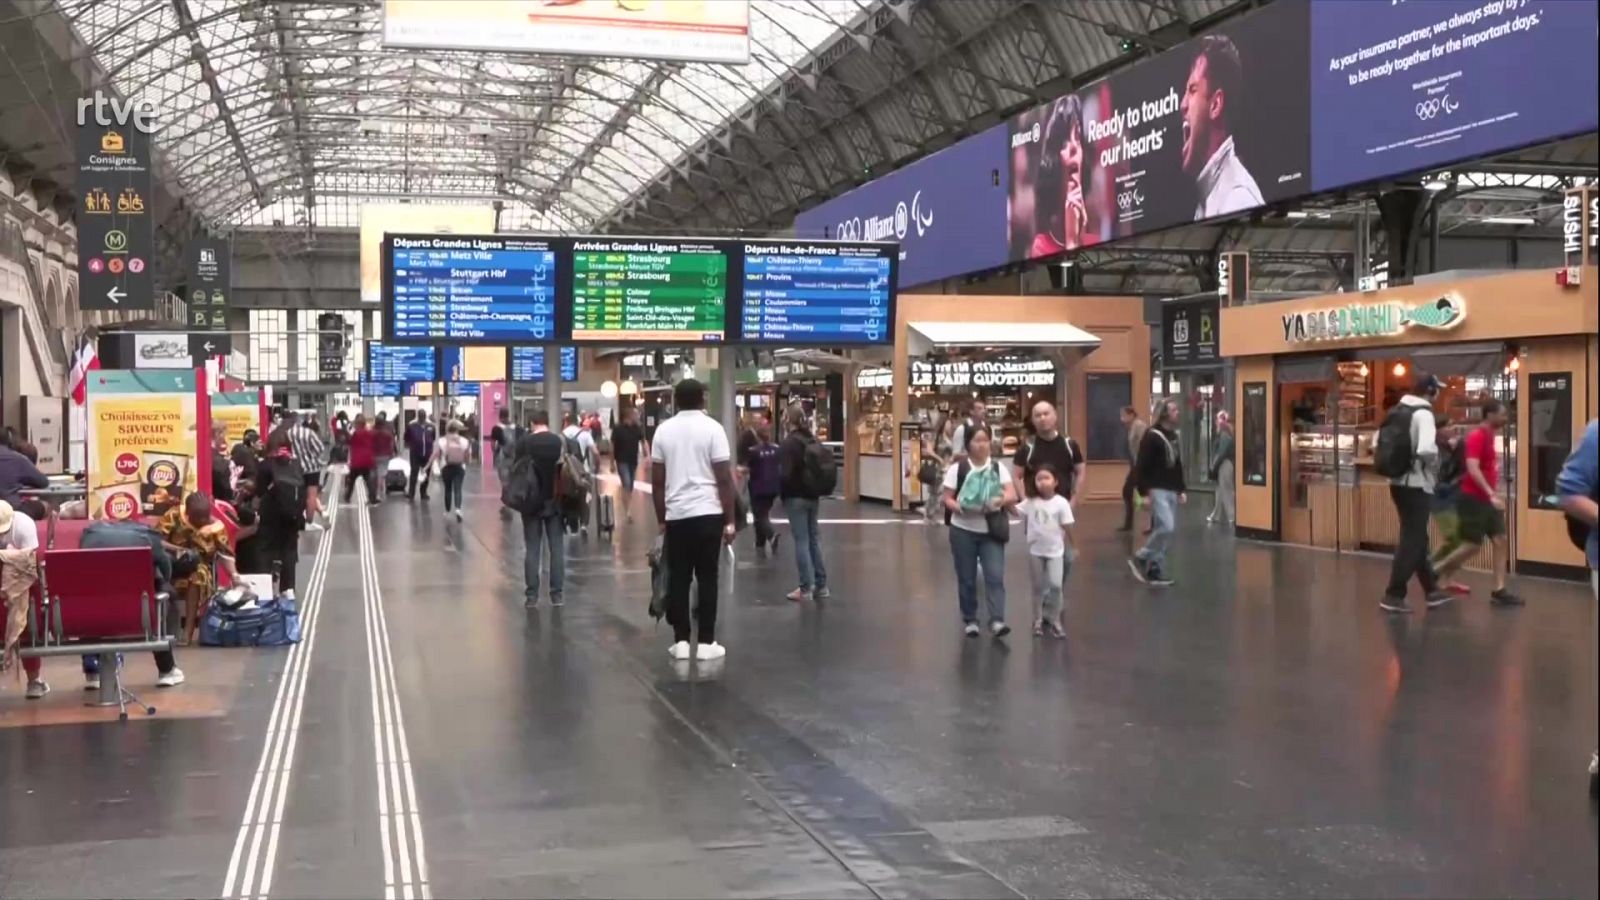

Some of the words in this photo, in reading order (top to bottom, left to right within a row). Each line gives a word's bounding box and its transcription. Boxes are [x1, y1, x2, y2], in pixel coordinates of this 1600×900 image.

[1330, 58, 1340, 71] As
[1341, 53, 1358, 70] your
[1359, 39, 1397, 60] insurance
[1398, 26, 1432, 49] partner,
[1433, 20, 1447, 34] we
[1449, 13, 1481, 29] always
[1483, 1, 1504, 16] stay
[1349, 74, 1358, 85] to
[1359, 69, 1369, 82] be
[1370, 60, 1393, 76] ready
[1395, 50, 1431, 70] together
[1432, 43, 1445, 58] for
[1446, 38, 1461, 53] the
[1463, 21, 1511, 48] important
[1088, 109, 1126, 143] Ready
[1127, 106, 1140, 127] to
[1142, 86, 1179, 122] touch
[90, 155, 137, 166] Consignes
[1100, 145, 1121, 167] our
[864, 216, 895, 241] Allianz
[1564, 196, 1581, 252] SUSHI
[393, 238, 431, 251] Départs
[433, 239, 472, 249] Grandes
[473, 239, 502, 251] Lignes
[573, 242, 610, 252] Arrivées
[612, 243, 648, 252] Grandes
[650, 244, 678, 254] Lignes
[744, 245, 778, 256] Départs
[628, 254, 671, 264] Strasbourg
[766, 256, 822, 265] Château-Thierry
[91, 260, 100, 270] 4
[451, 269, 490, 279] Stuttgart
[491, 269, 507, 278] Hbf
[627, 272, 671, 281] Strasbourg
[766, 273, 792, 281] Provins
[912, 373, 933, 386] LE
[935, 373, 971, 386] PAIN
[973, 373, 1055, 386] QUOTIDIEN
[101, 412, 160, 423] Choisissez
[162, 412, 181, 421] vos
[119, 424, 174, 434] saveurs
[115, 435, 169, 447] préférées
